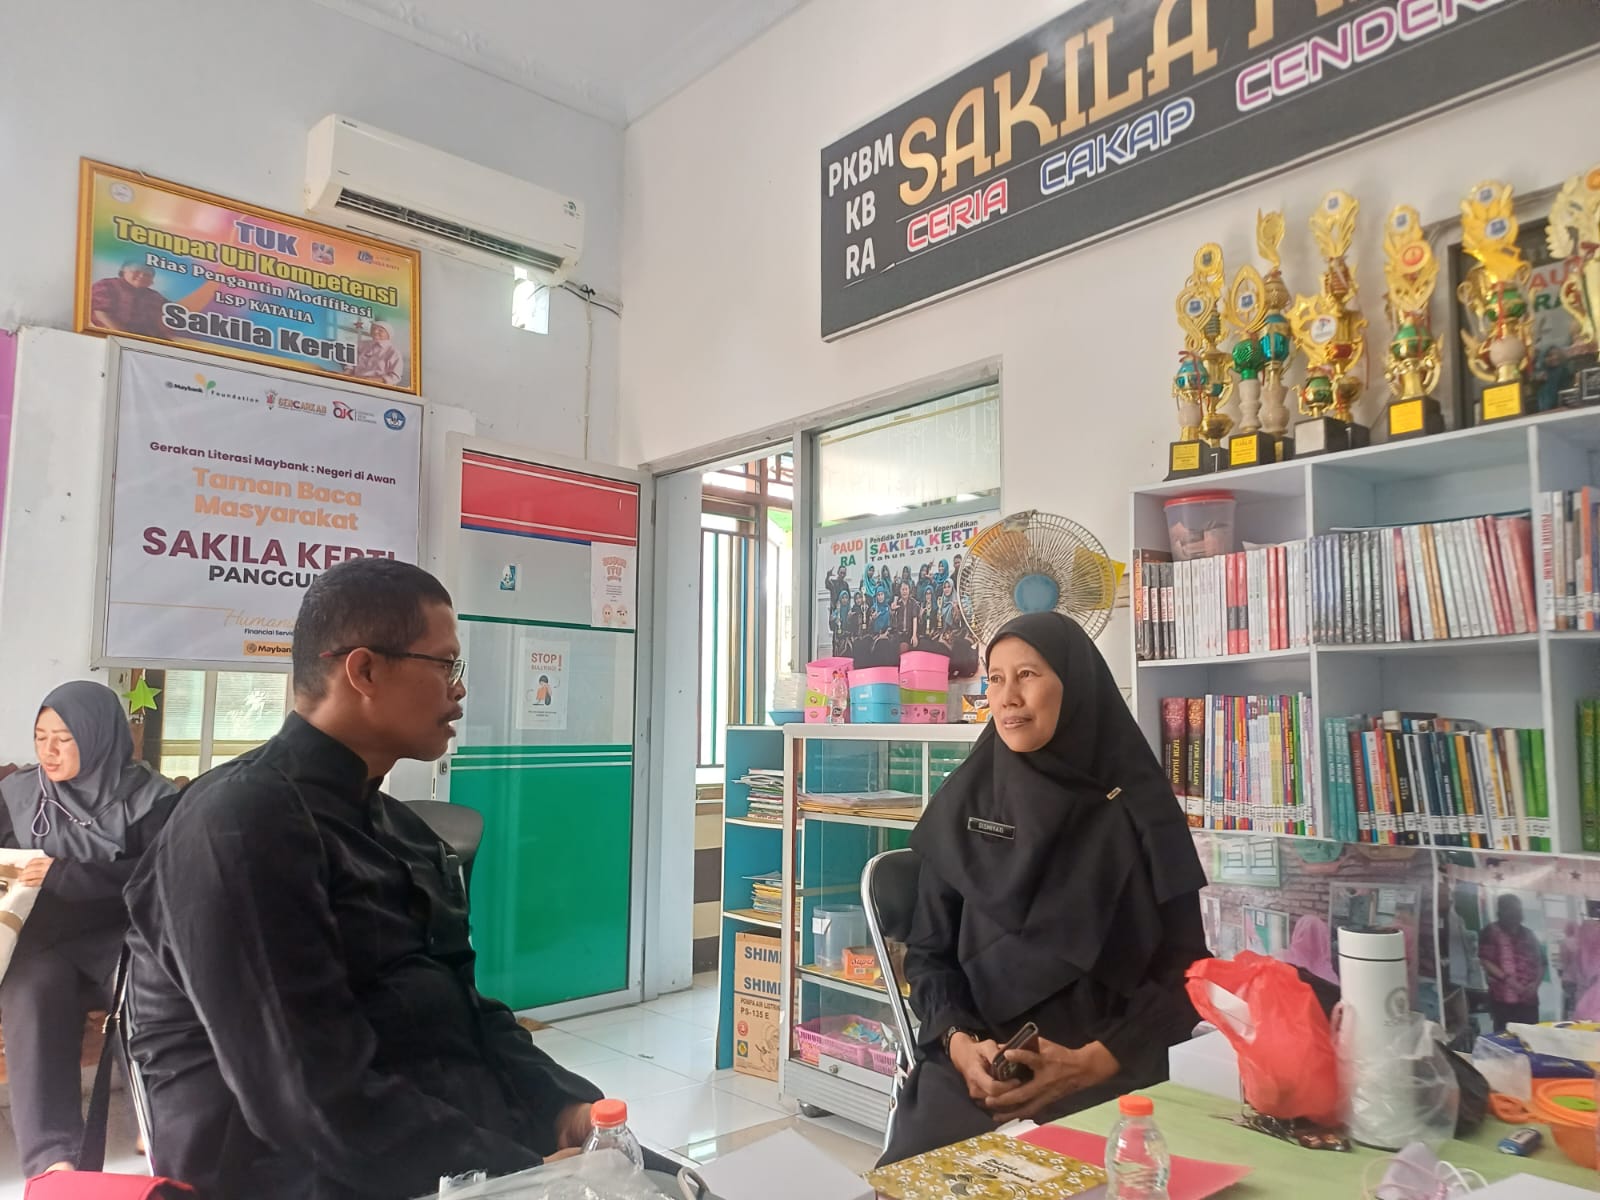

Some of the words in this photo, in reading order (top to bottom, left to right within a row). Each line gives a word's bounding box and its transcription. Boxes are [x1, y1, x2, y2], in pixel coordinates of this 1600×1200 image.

[900, 0, 1218, 206] SAKILA
[828, 132, 896, 198] PKBM
[1040, 97, 1196, 196] CAKAP
[845, 190, 877, 234] KB
[907, 178, 1009, 252] CERIA
[234, 220, 298, 256] TUK
[113, 216, 218, 263] Tempat
[220, 243, 256, 272] Uji
[259, 254, 398, 307] Kompetensi
[845, 237, 877, 280] RA
[145, 252, 188, 274] Rias
[191, 263, 284, 297] Pengantin
[287, 287, 374, 318] Modifikasi
[215, 291, 246, 309] LSP
[248, 302, 315, 325] KATALIA
[162, 303, 273, 349] Sakila
[280, 328, 358, 367] Kerti
[174, 383, 203, 393] Maybank
[210, 390, 259, 403] Foundation
[150, 441, 205, 458] Gerakan
[207, 448, 252, 464] Literasi
[254, 456, 309, 473] Maybank
[316, 465, 352, 480] Negeri
[354, 470, 365, 481] di
[366, 473, 396, 485] Awan
[192, 466, 292, 497] Taman
[297, 481, 362, 507] Baca
[194, 494, 359, 531] Masyarakat
[142, 526, 288, 567] SAKILA
[831, 538, 864, 556] PAUD
[870, 534, 895, 544] Pendidik
[896, 531, 909, 540] Dan
[909, 528, 932, 537] Tenaga
[933, 520, 979, 533] Kependidikan
[870, 536, 925, 556] SAKILA
[929, 527, 979, 546] KERTI
[840, 554, 857, 567] RA
[870, 552, 906, 563] Tahun
[208, 565, 320, 589] PANGGU
[224, 607, 294, 628] Humani
[244, 628, 275, 636] Financial
